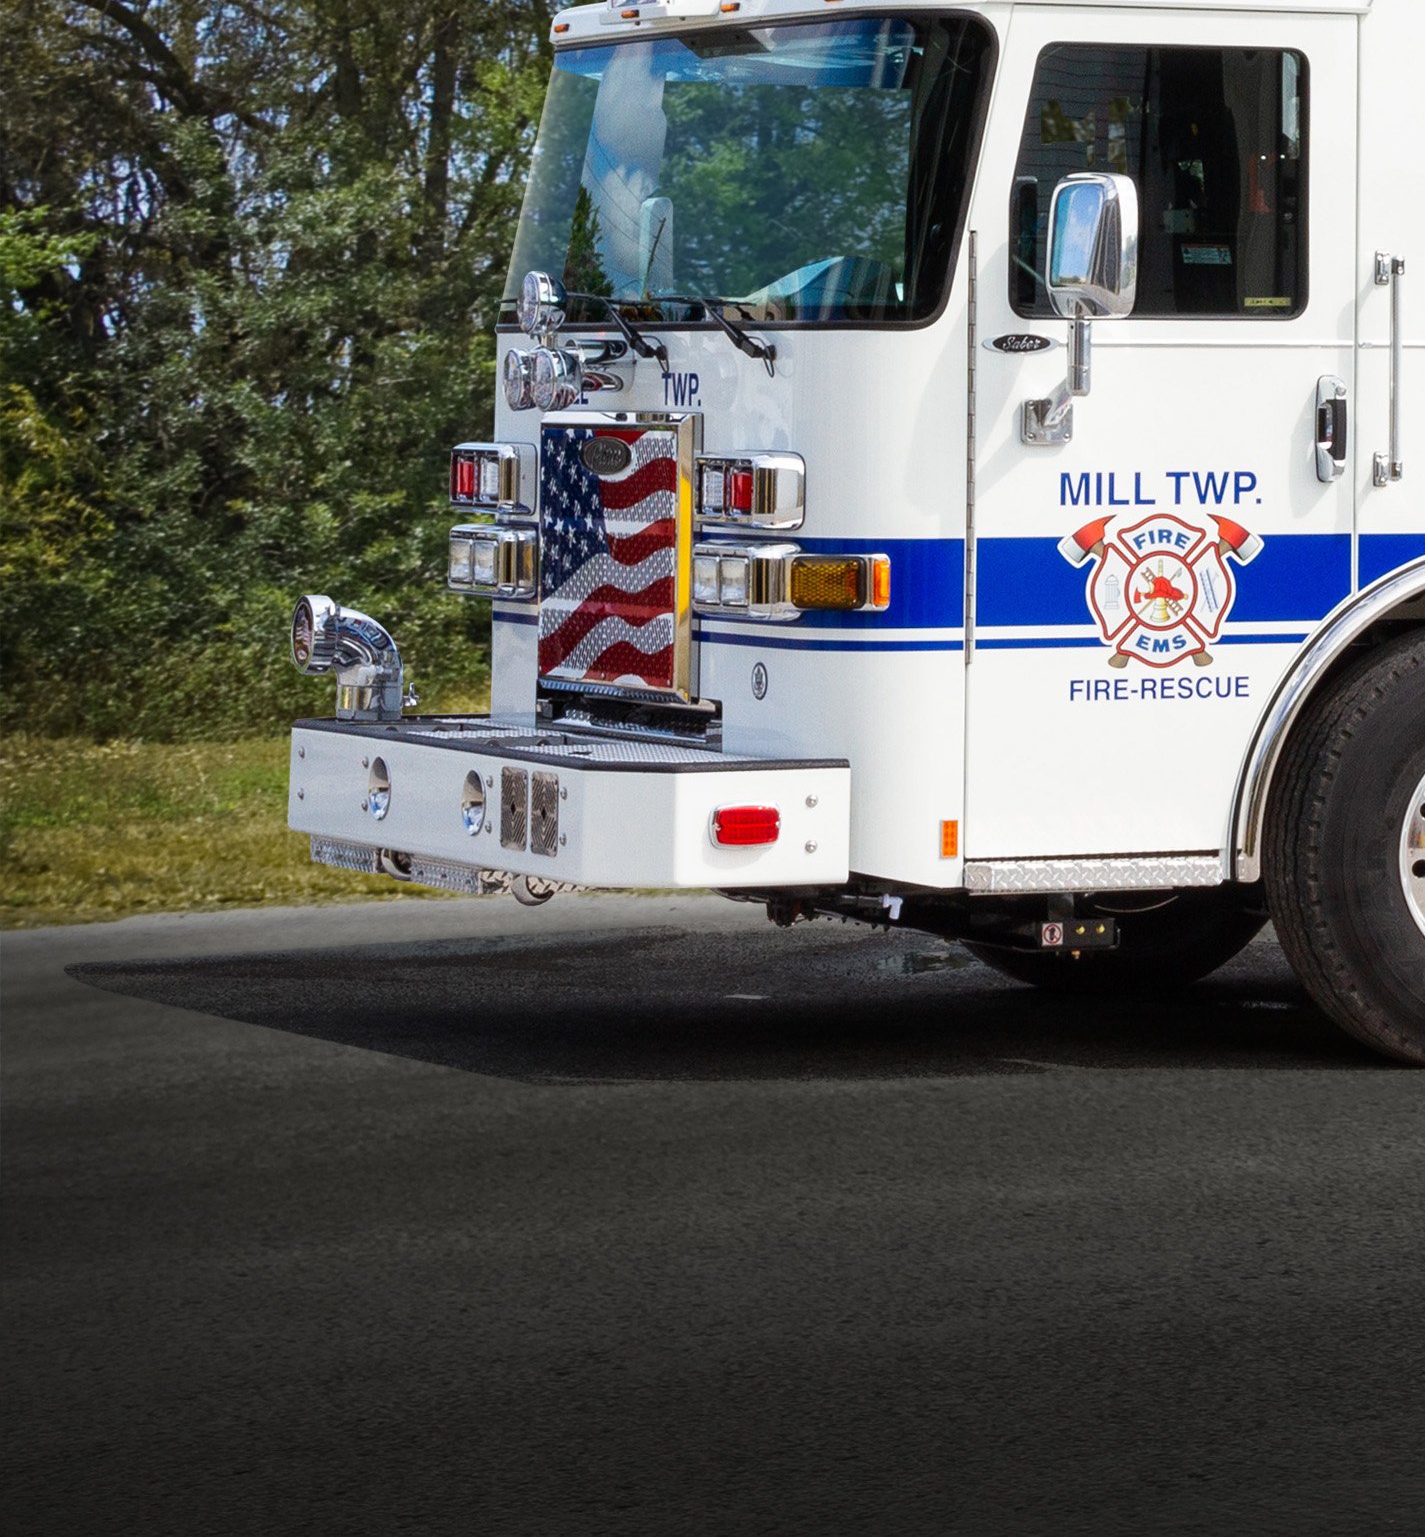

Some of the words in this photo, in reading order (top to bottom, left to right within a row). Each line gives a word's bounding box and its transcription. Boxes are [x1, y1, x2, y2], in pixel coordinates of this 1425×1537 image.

[1002, 335, 1041, 350] Saber
[661, 372, 702, 407] TWP.
[1060, 472, 1156, 506] MILL
[1165, 471, 1263, 505] TWP.
[1133, 528, 1192, 551] FIRE
[1136, 634, 1188, 654] EMS
[1069, 676, 1250, 702] FIRE-RESCUE
